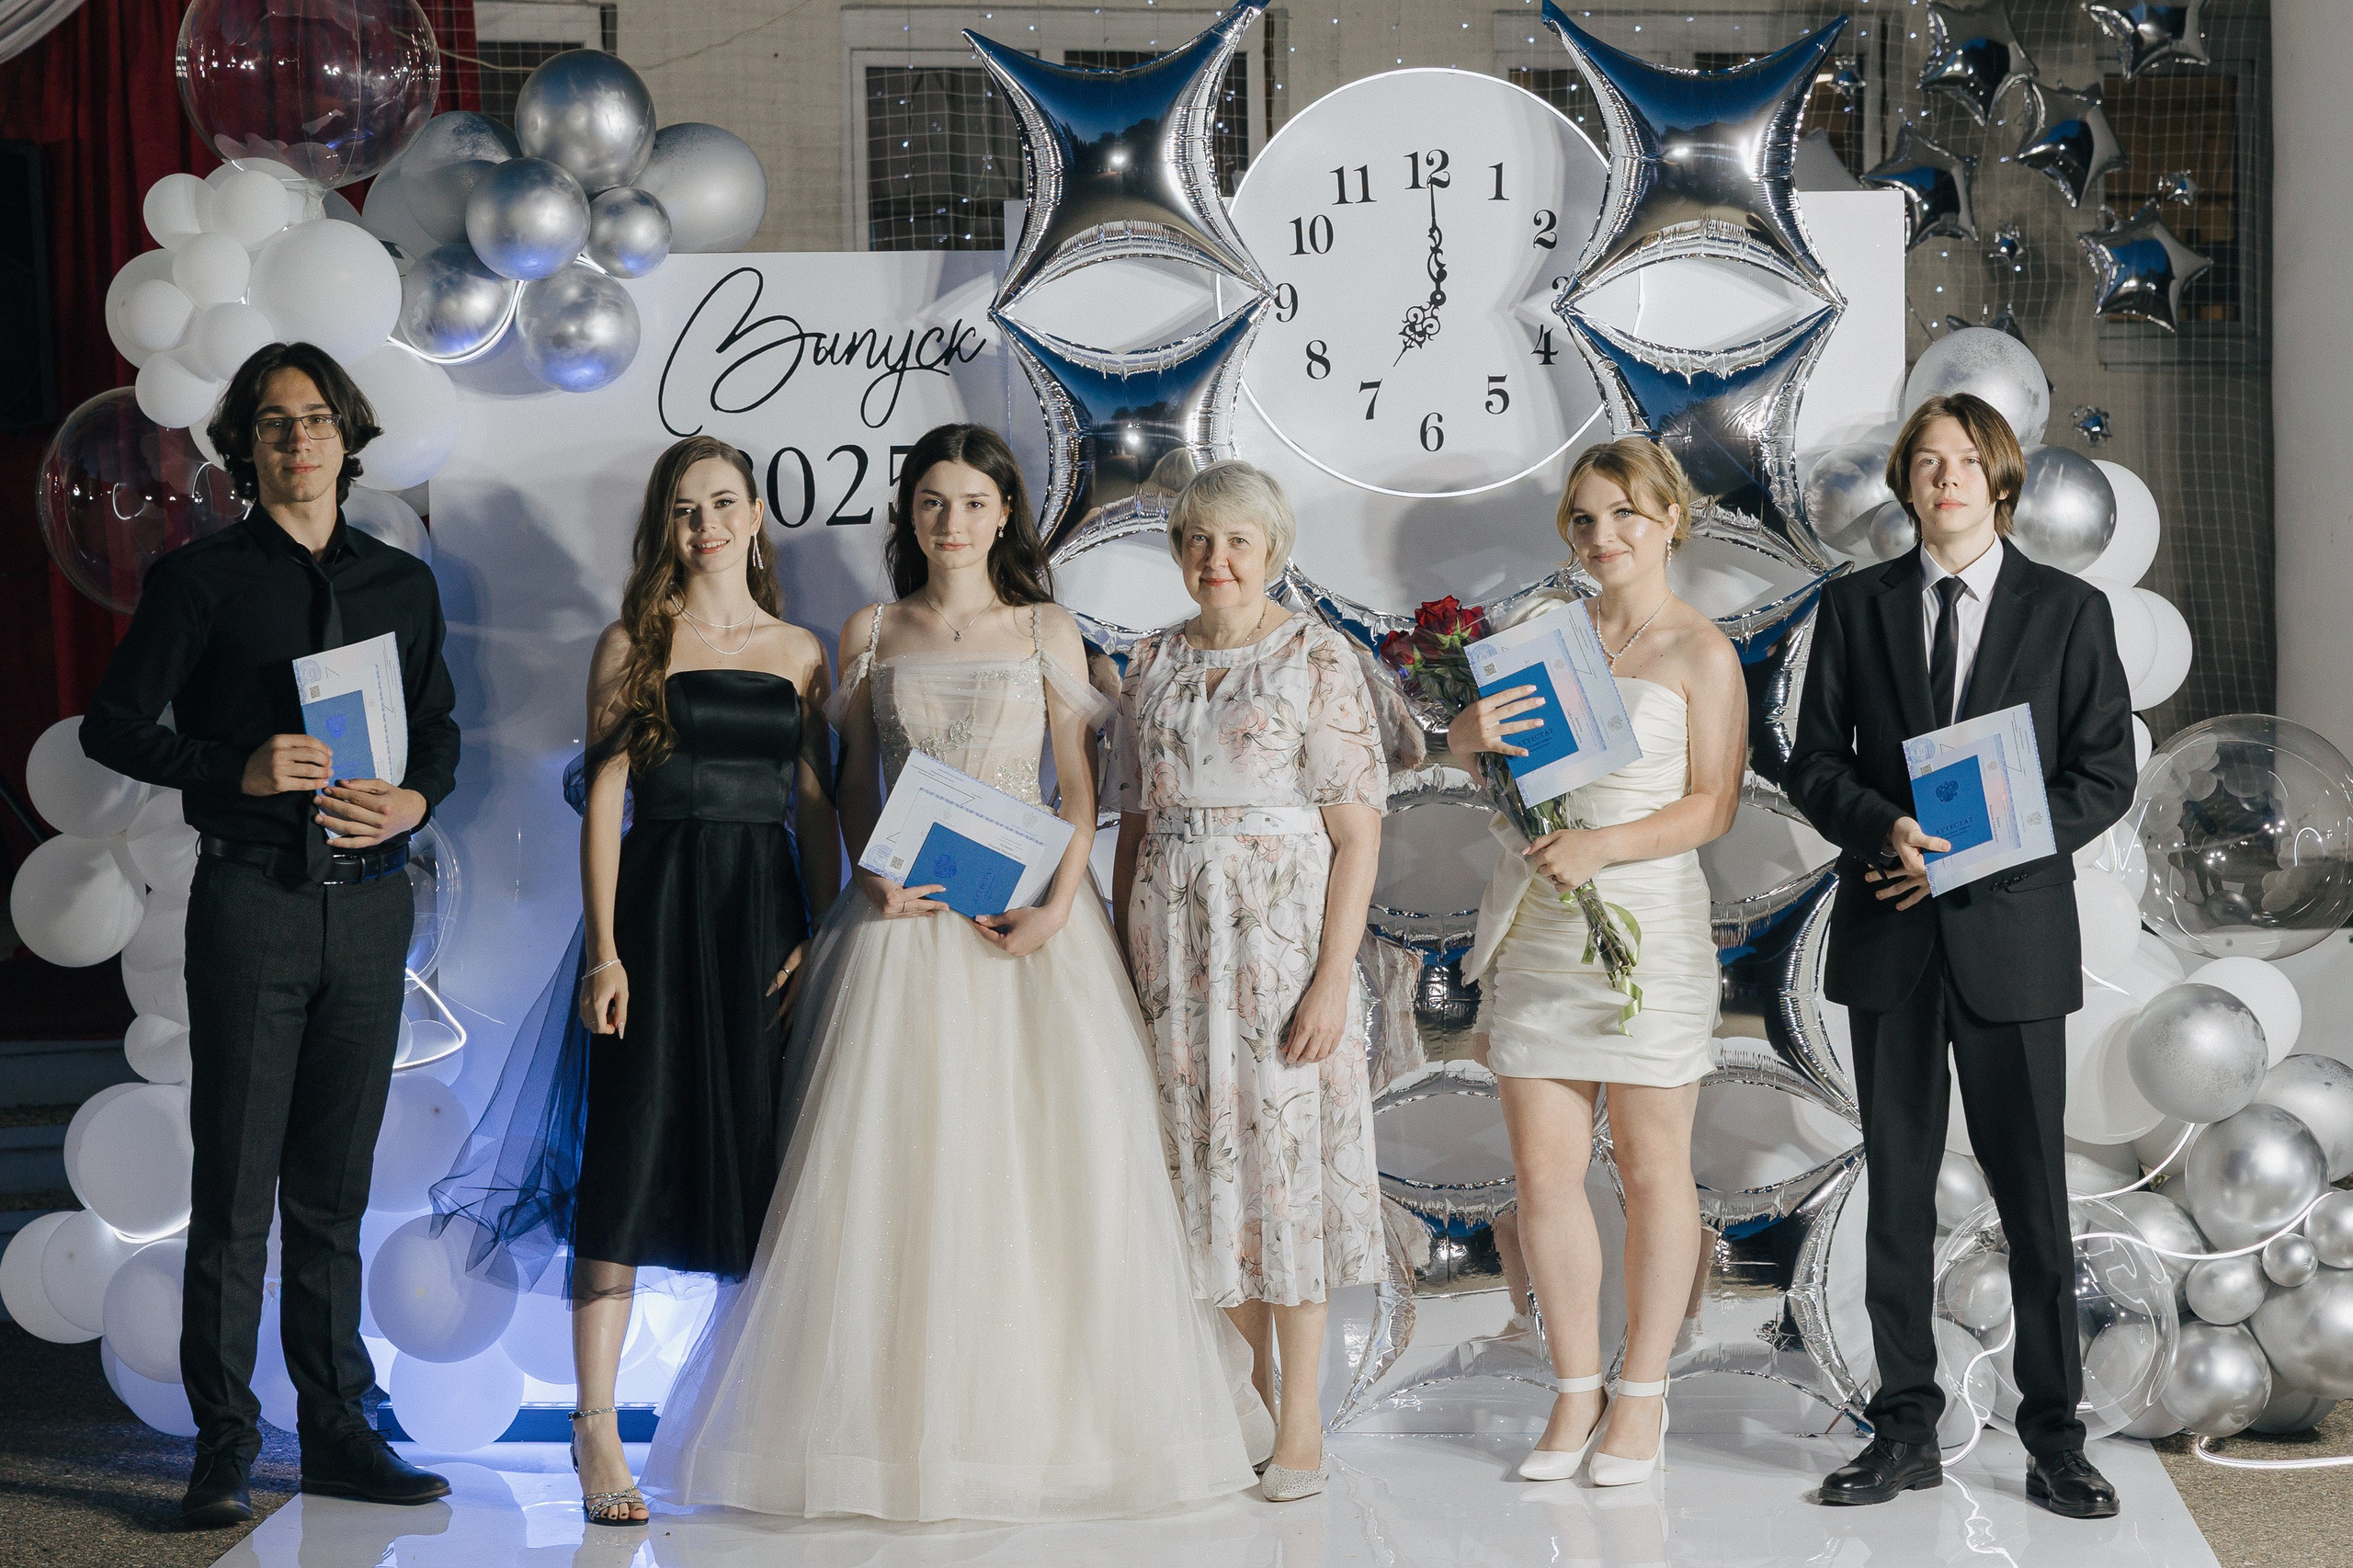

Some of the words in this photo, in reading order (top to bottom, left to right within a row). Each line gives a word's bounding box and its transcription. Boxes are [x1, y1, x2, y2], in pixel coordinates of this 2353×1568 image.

[1329, 164, 1377, 205] 11
[1404, 149, 1450, 190] 12
[1488, 162, 1510, 201] 1
[1289, 214, 1334, 256] 10
[1533, 210, 1558, 250] 2
[1274, 282, 1299, 323] 9
[657, 267, 987, 437] Выпуск
[1305, 339, 1332, 380] 8
[1530, 324, 1559, 366] 4
[1358, 378, 1383, 420] 7
[1484, 374, 1510, 415] 5
[1420, 412, 1444, 452] 6
[736, 444, 916, 528] 02
